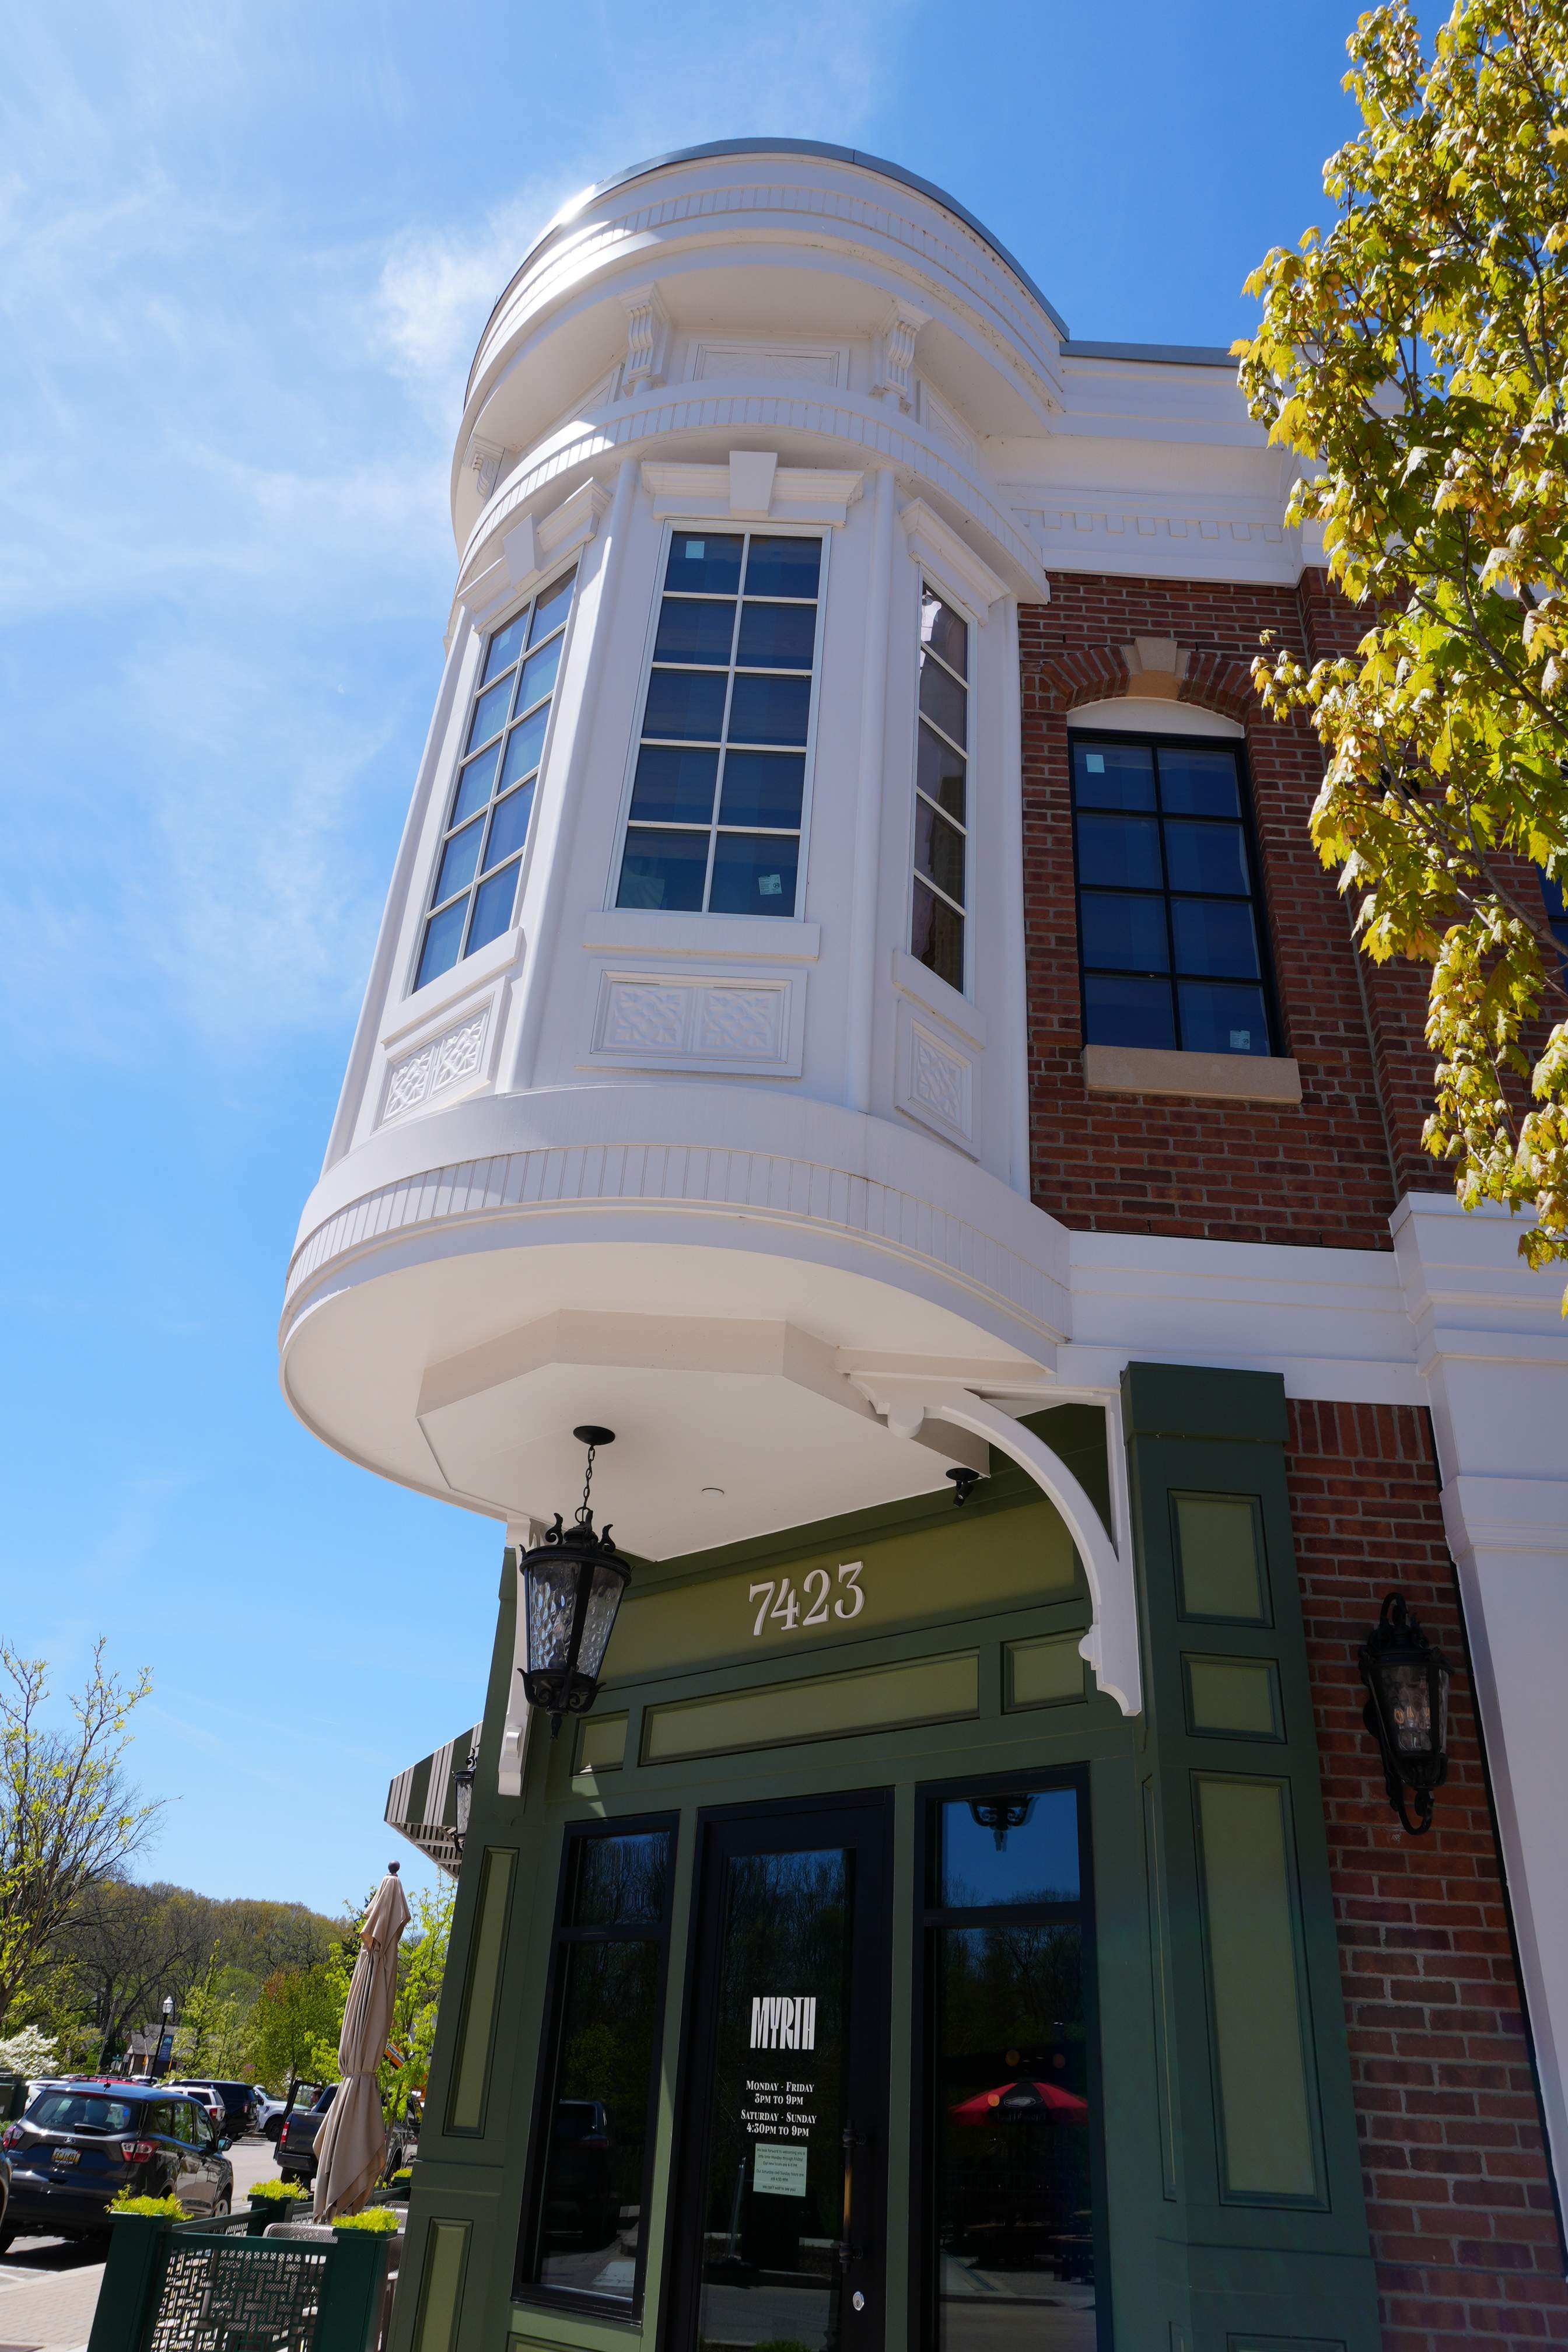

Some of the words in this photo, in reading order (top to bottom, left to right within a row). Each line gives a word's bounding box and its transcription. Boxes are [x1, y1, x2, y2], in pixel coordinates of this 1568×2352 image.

[749, 1561, 865, 1636] 7423
[750, 1997, 816, 2050] MYRTH
[746, 2080, 779, 2091] MONDAY
[786, 2081, 814, 2092] FRIDAY
[755, 2093, 771, 2104] 3PM
[773, 2095, 784, 2104] TO
[786, 2094, 803, 2105] 9PM
[741, 2109, 779, 2122] SATURDAY
[786, 2112, 817, 2124] SUNDAY
[747, 2122, 776, 2134] 4:30PM
[779, 2126, 789, 2135] TO
[792, 2125, 809, 2137] 9PM
